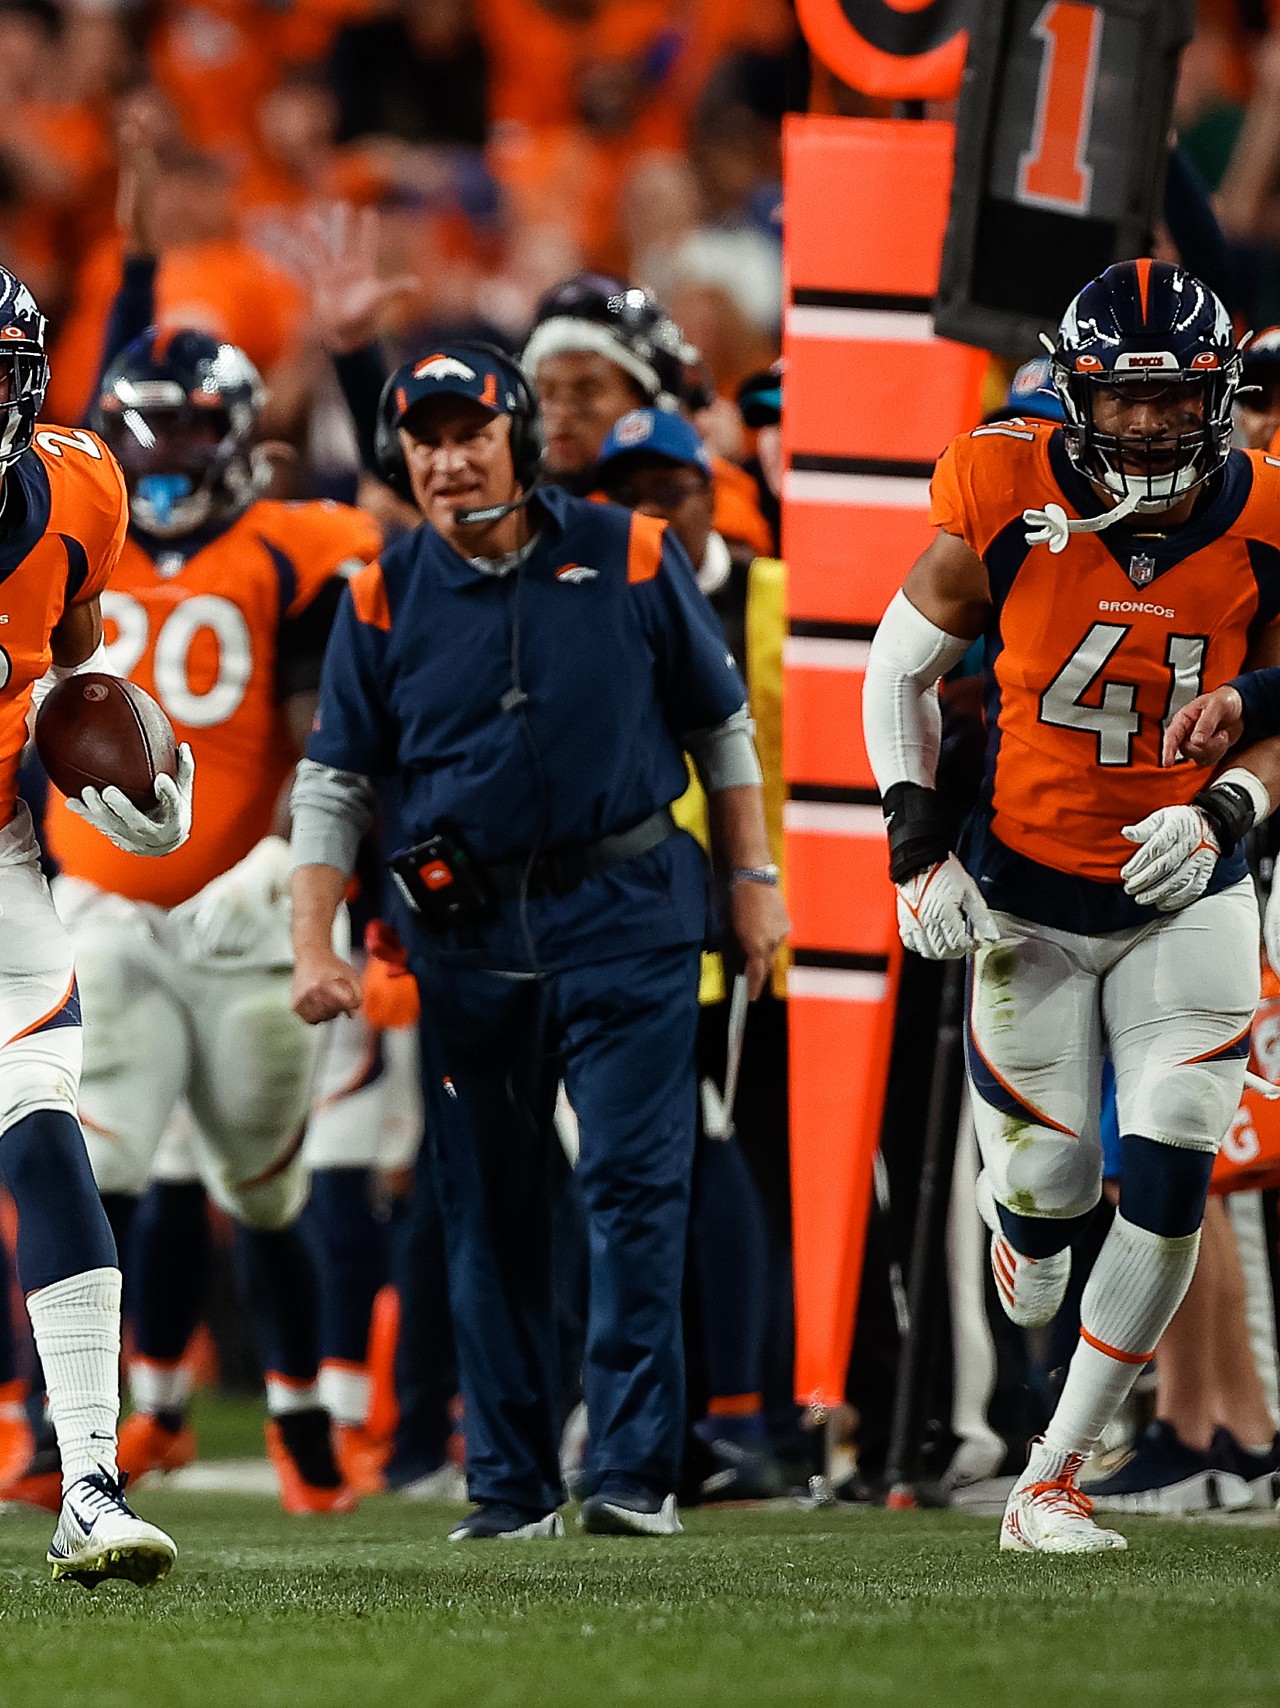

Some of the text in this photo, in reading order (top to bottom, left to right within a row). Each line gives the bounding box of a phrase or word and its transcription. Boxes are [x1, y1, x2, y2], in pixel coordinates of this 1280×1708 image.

[1017, 0, 1106, 215] 1
[35, 429, 103, 460] 2
[1098, 600, 1175, 618] BRONCOS
[1039, 622, 1207, 767] 41
